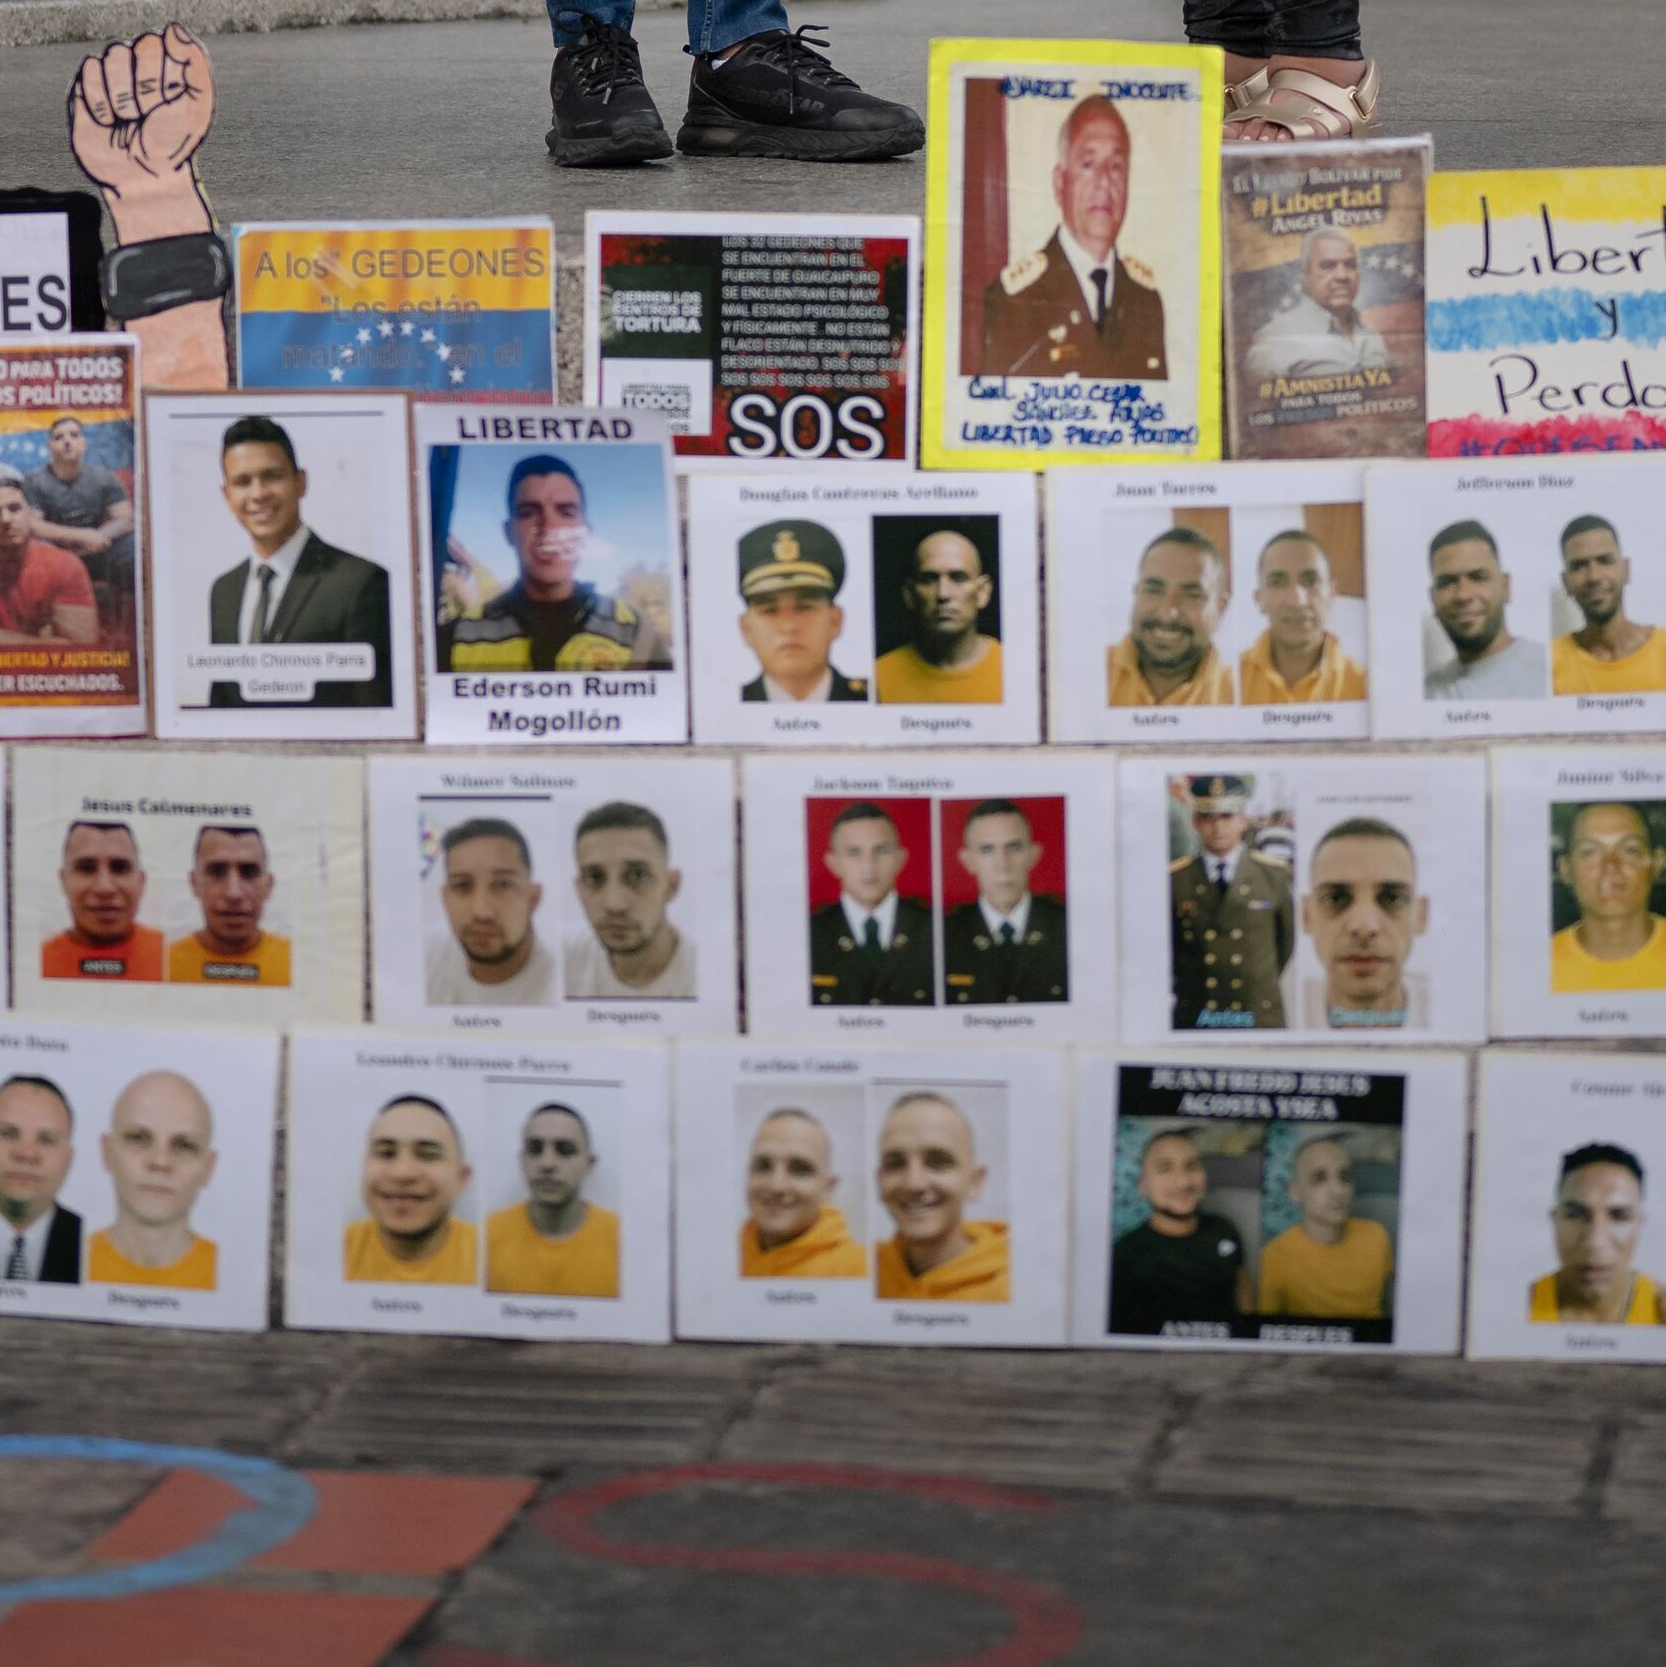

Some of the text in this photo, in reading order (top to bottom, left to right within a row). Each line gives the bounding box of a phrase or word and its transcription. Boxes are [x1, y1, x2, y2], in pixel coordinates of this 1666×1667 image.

[1250, 184, 1382, 217] #Libertad
[255, 251, 279, 279] A
[352, 247, 547, 279] GEDEONES
[1595, 298, 1620, 340] y
[56, 356, 123, 379] TODOS
[458, 417, 633, 440] LIBERTAD
[728, 393, 885, 460] SOS
[453, 676, 658, 699] Ederson Rumi
[488, 706, 622, 737] Mogollón
